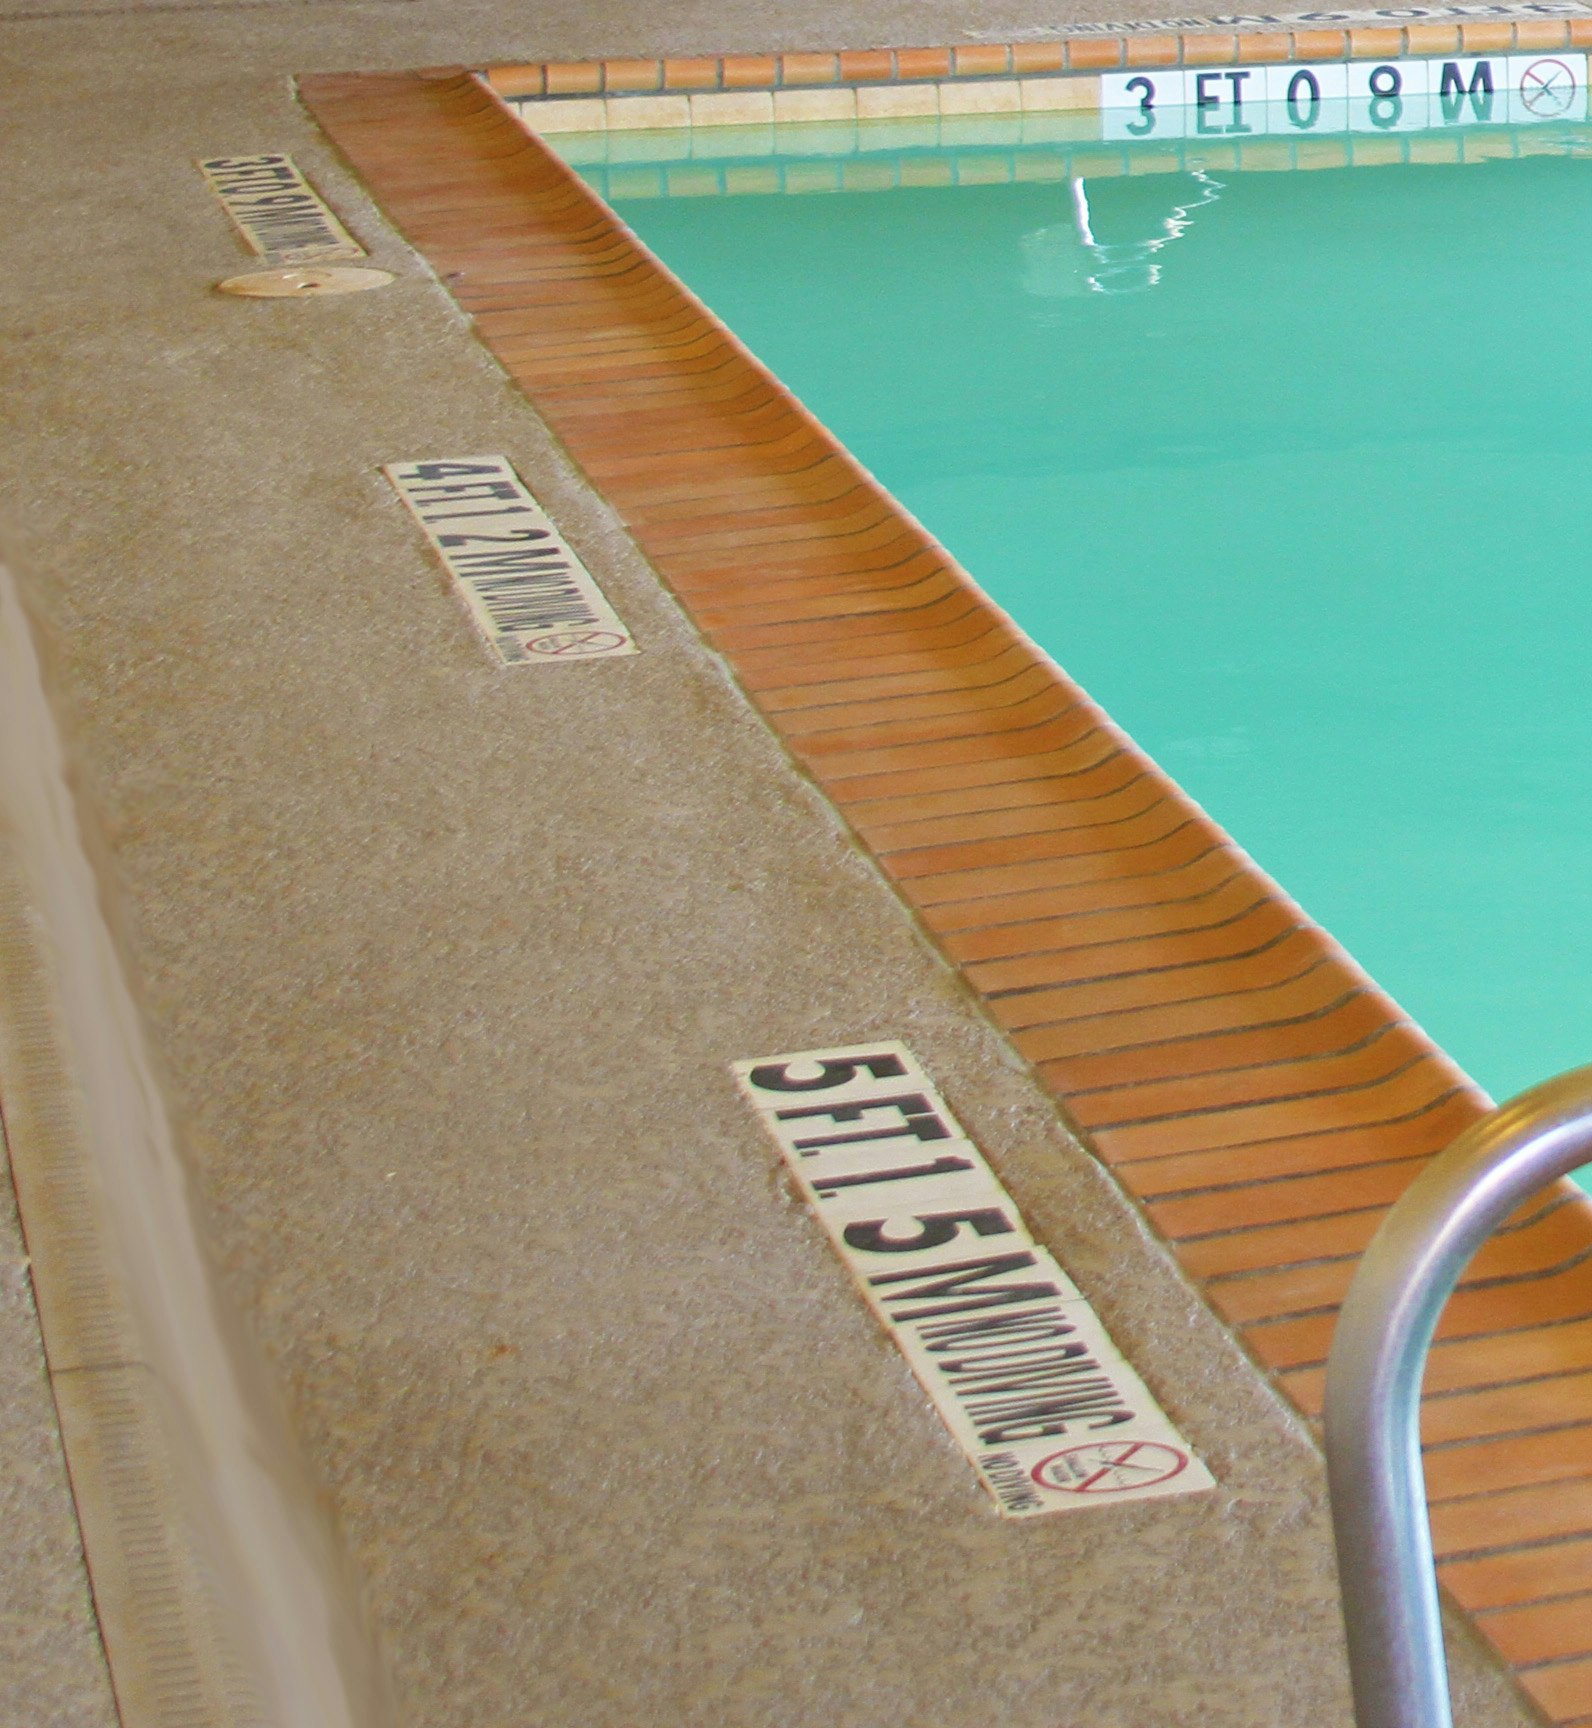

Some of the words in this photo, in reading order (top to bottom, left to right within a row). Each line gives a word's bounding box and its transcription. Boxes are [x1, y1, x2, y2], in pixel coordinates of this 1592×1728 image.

[1440, 61, 1495, 97] M
[203, 155, 285, 169] 3
[398, 461, 503, 481] 4
[437, 528, 551, 548] 2
[448, 547, 571, 578] M
[471, 572, 577, 593] NO
[481, 587, 600, 633] DIVING
[750, 1052, 909, 1093] 5
[843, 1206, 1017, 1254] 5
[867, 1250, 1064, 1323] M
[916, 1306, 1077, 1354] NO
[938, 1340, 1138, 1446] DIVING
